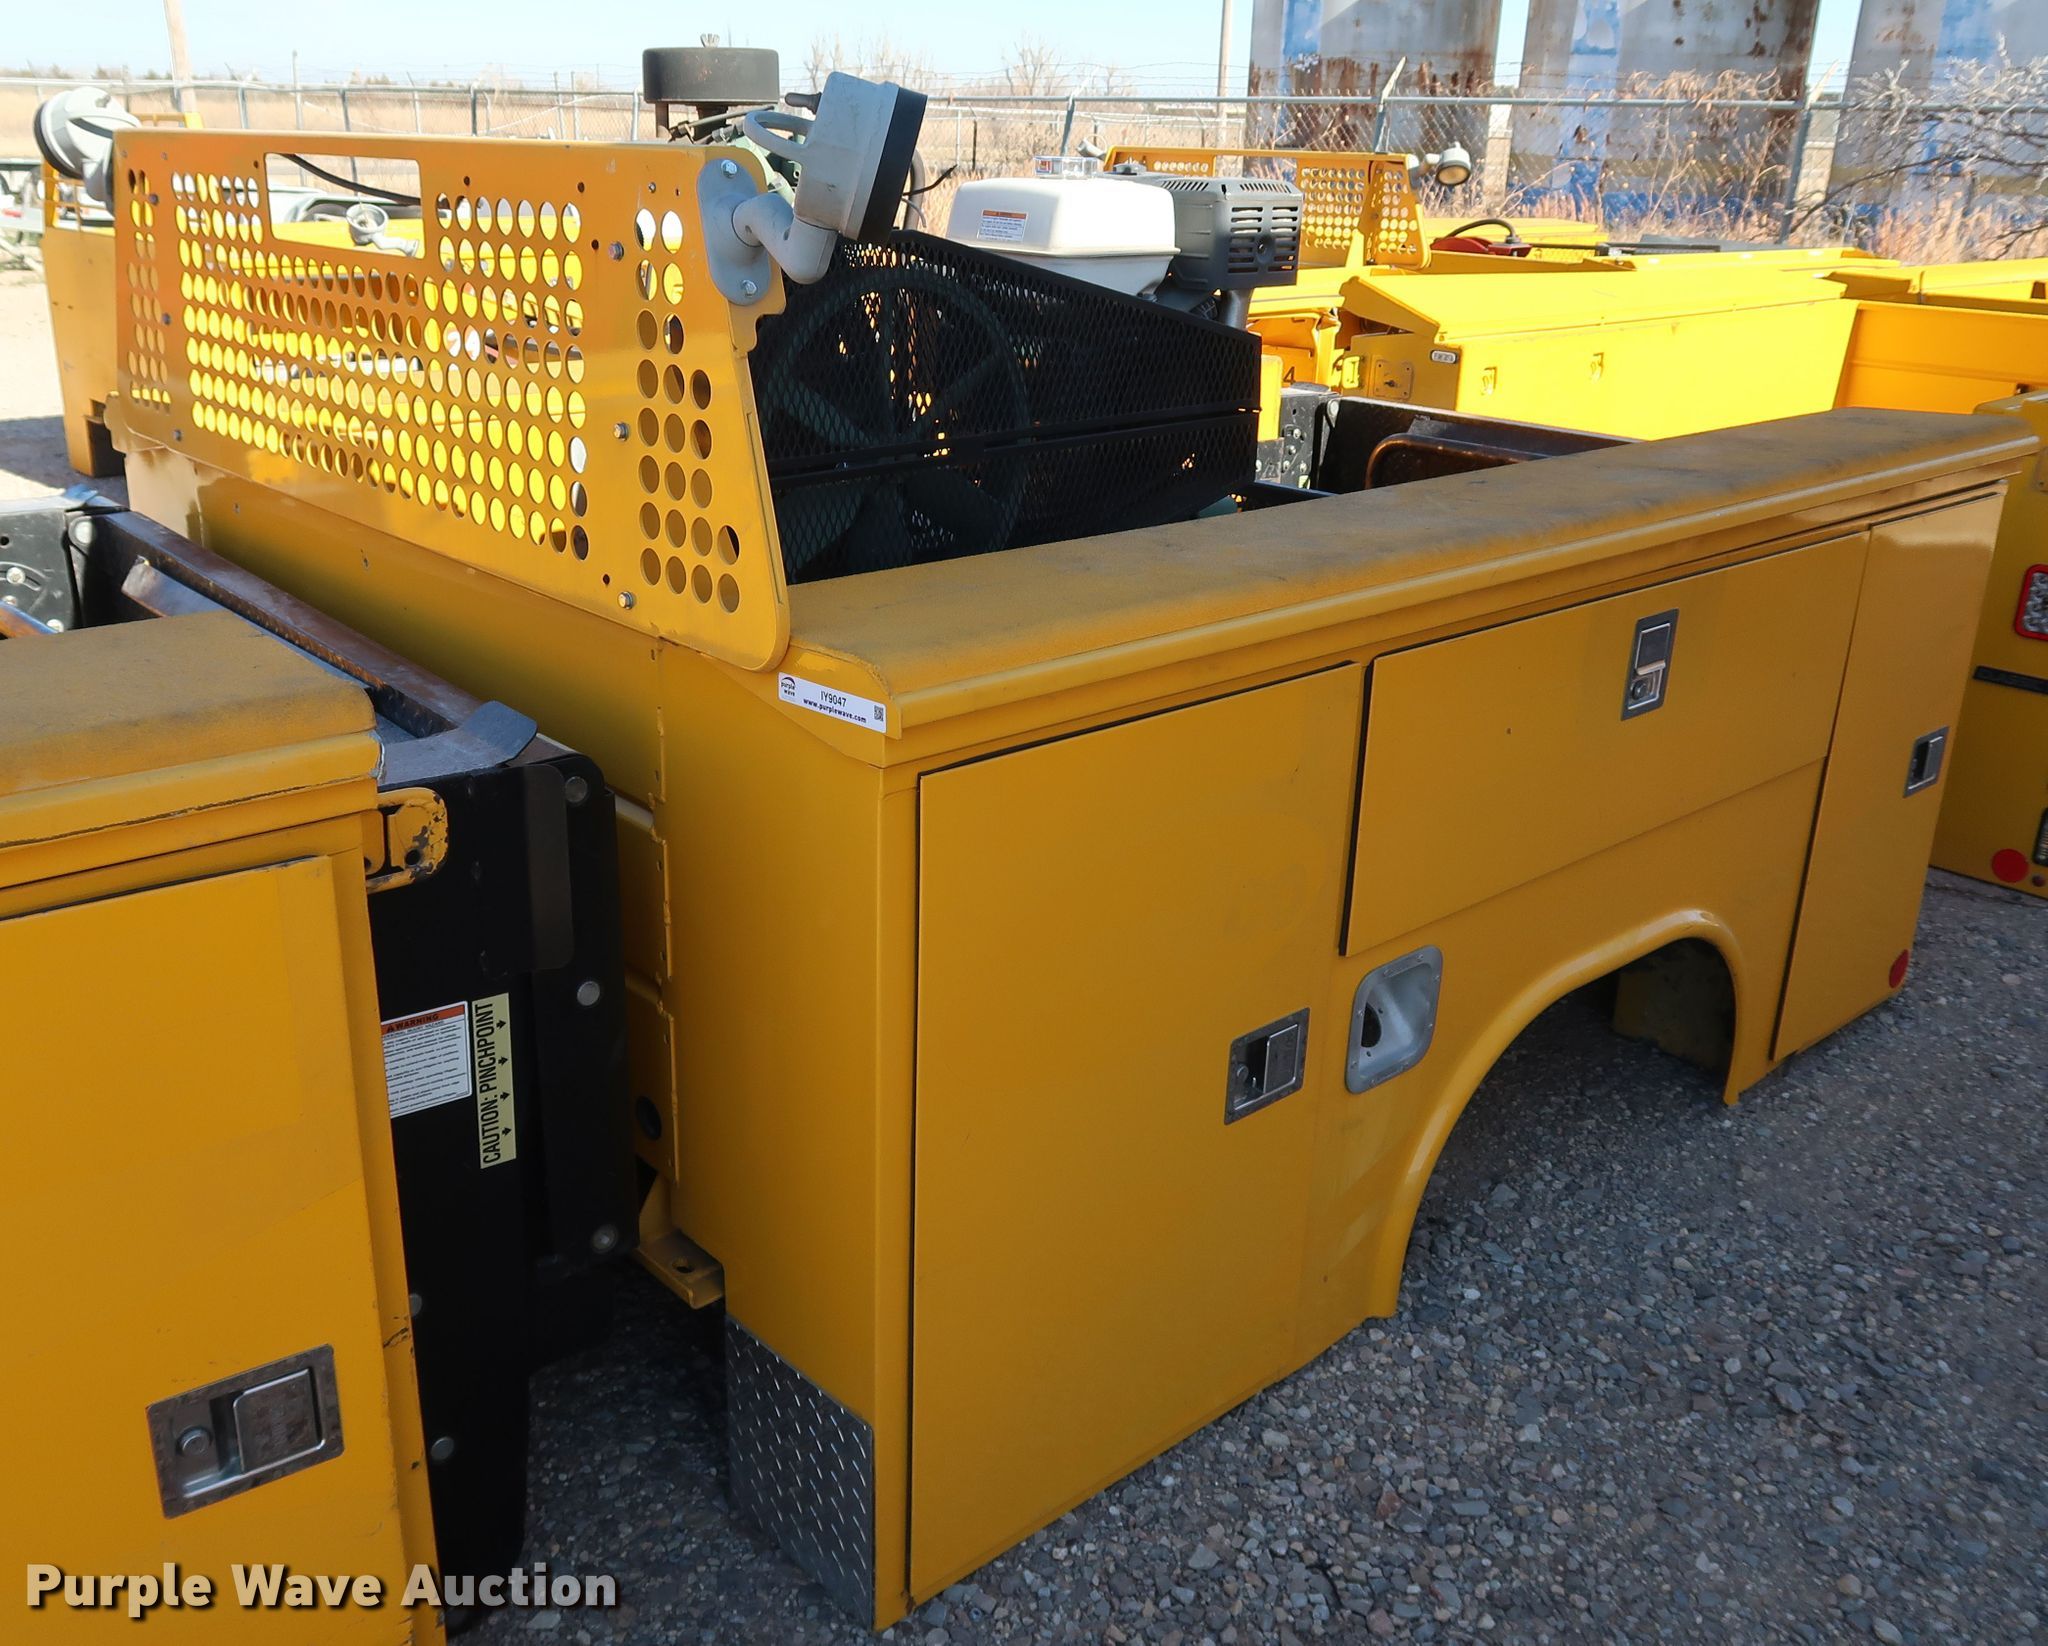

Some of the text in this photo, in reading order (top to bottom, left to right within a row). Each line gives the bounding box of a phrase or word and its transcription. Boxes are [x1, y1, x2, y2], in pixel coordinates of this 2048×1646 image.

[820, 690, 847, 708] IY9047
[803, 698, 867, 723] www.purplewave.com
[396, 1014, 439, 1030] WARNING
[475, 1003, 500, 1164] CAUTION: PINCHPOINT
